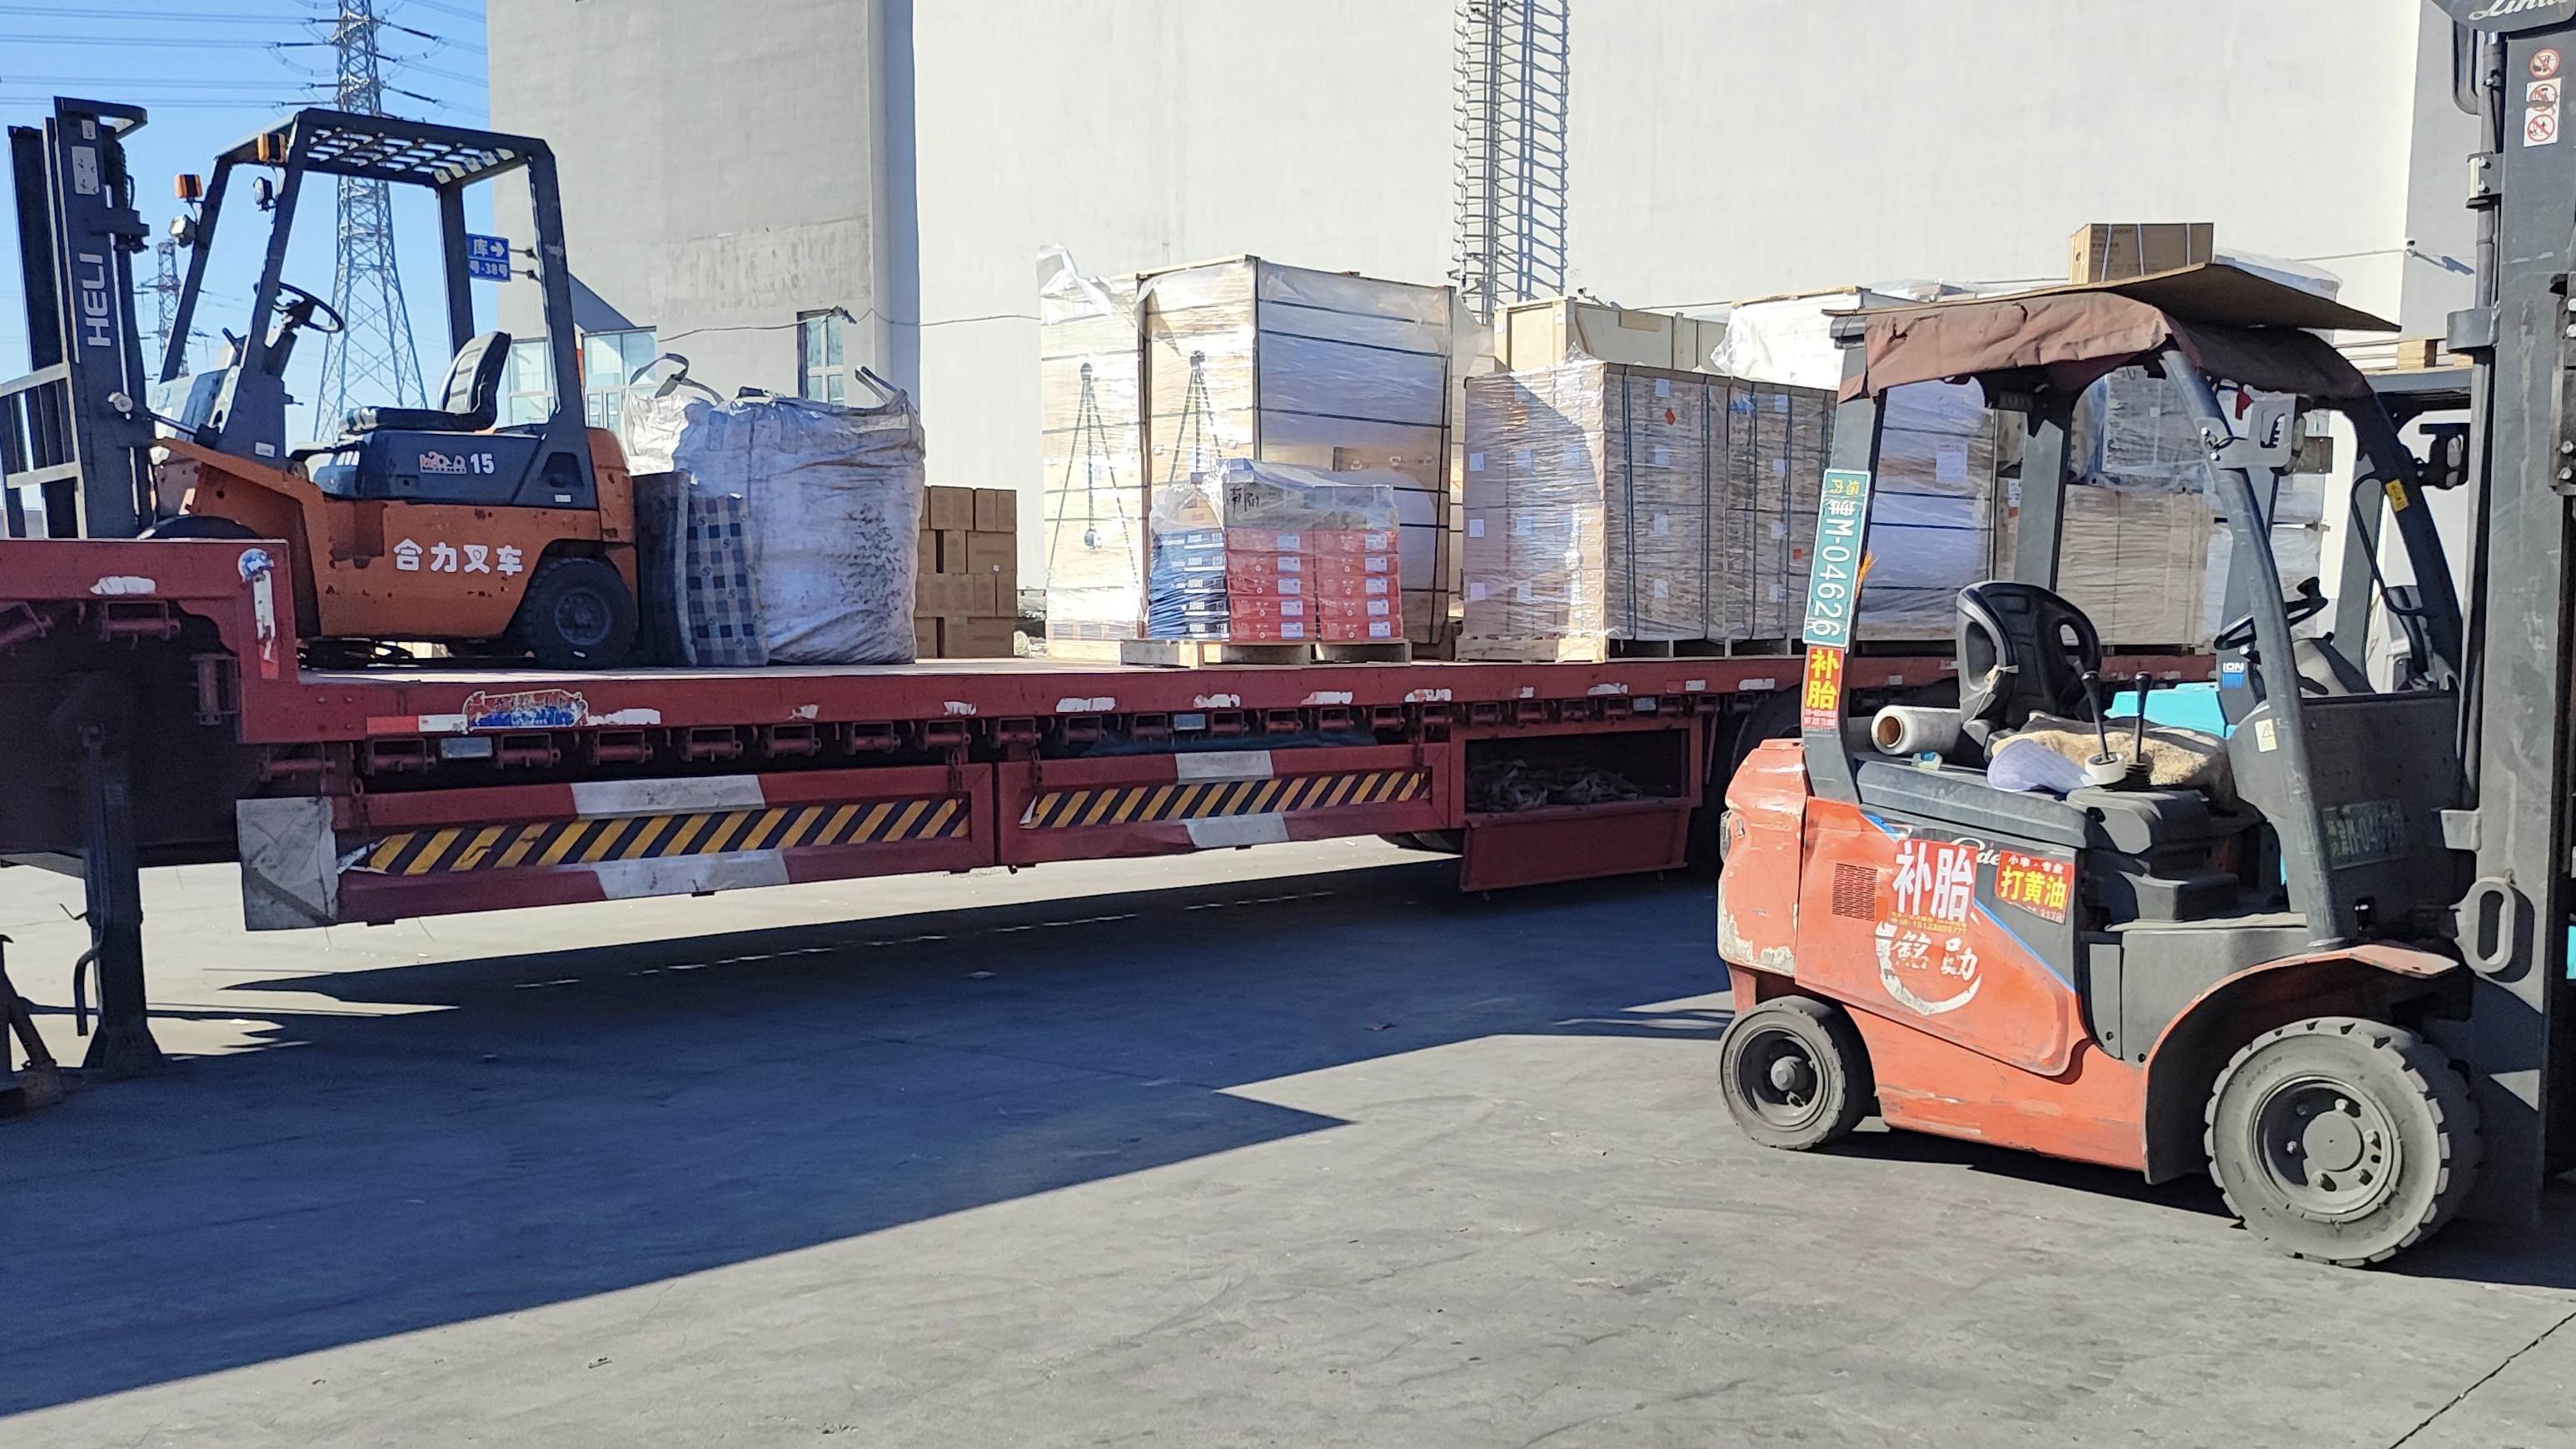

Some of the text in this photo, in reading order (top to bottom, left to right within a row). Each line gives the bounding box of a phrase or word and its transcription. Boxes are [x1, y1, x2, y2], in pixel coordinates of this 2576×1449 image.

[2468, 0, 2569, 20] Lin
[79, 252, 112, 346] HELI
[470, 453, 495, 474] 15
[393, 538, 523, 576] 合力叉车
[1806, 649, 1840, 710] 补胎
[1892, 840, 1973, 923] 补胎
[2000, 865, 2067, 910] 打黄油
